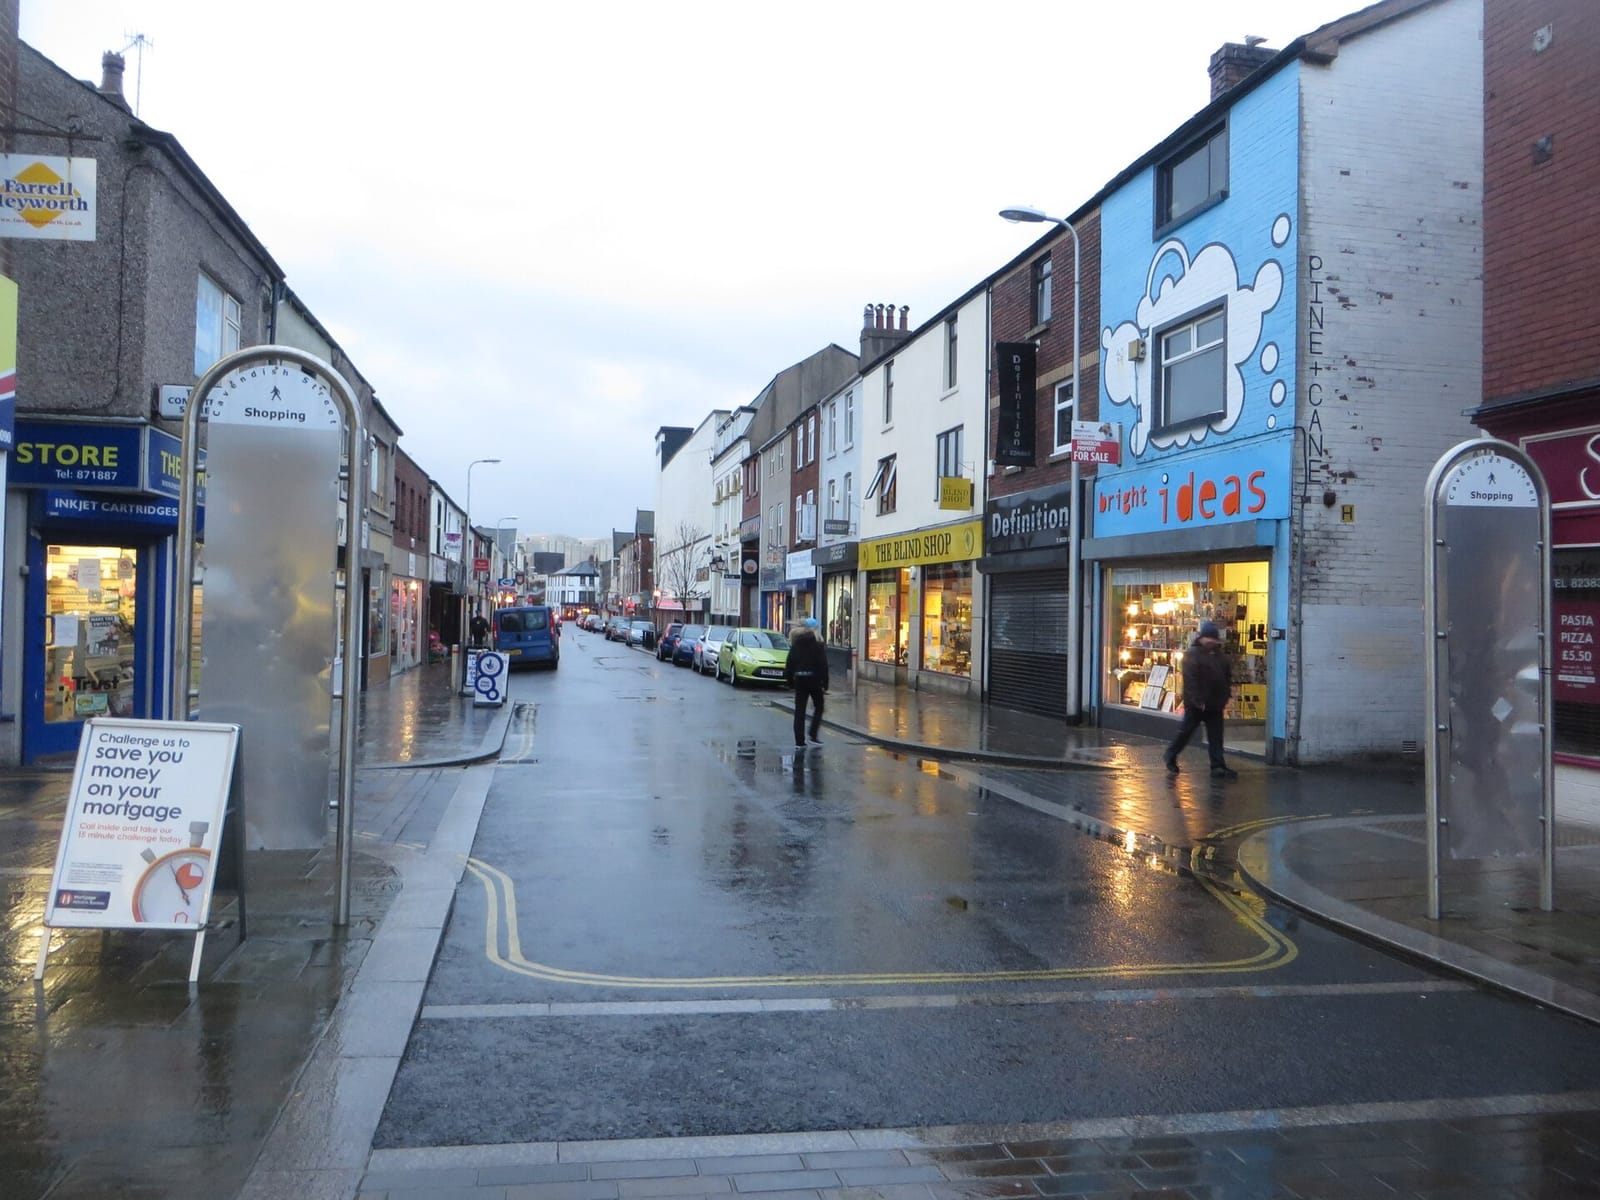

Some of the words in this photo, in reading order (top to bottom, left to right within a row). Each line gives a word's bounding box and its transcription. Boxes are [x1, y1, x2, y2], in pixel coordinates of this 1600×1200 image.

[4, 179, 74, 196] Farrell
[0, 194, 89, 212] eyworth
[213, 367, 289, 417] Cavendish
[302, 376, 337, 424] Street
[1012, 354, 1021, 446] Definition
[244, 407, 307, 423] Shopping
[16, 442, 119, 467] STORE
[1073, 451, 1089, 461] FOR
[1090, 452, 1109, 462] SALE
[160, 450, 181, 479] THE
[56, 469, 73, 479] Tel:
[77, 470, 118, 481] 871887
[1098, 484, 1148, 514] bright
[1158, 470, 1266, 524] ideas
[1470, 491, 1513, 502] Shopping
[55, 498, 98, 511] INKJET
[101, 502, 178, 516] CARTRIDGES
[1342, 506, 1353, 521] H
[991, 502, 1070, 537] Definition
[875, 542, 892, 563] THE
[893, 537, 920, 561] BLIND
[924, 533, 951, 558] SHOP
[1560, 615, 1594, 626] PASTA
[1560, 632, 1593, 643] PIZZA
[1562, 650, 1592, 661] £5.50
[99, 733, 160, 747] Challenge
[163, 739, 176, 747] us
[179, 738, 190, 748] to
[95, 746, 142, 761] save
[148, 750, 183, 765] you
[91, 765, 161, 784] money
[87, 783, 112, 796] on
[118, 785, 162, 801] your
[82, 800, 182, 822] mortgage
[79, 822, 96, 830] Call
[97, 823, 120, 831] inside
[122, 824, 138, 832] and
[140, 825, 159, 833] take
[87, 831, 115, 839] minute
[117, 833, 158, 843] challenge
[159, 836, 183, 844] today
